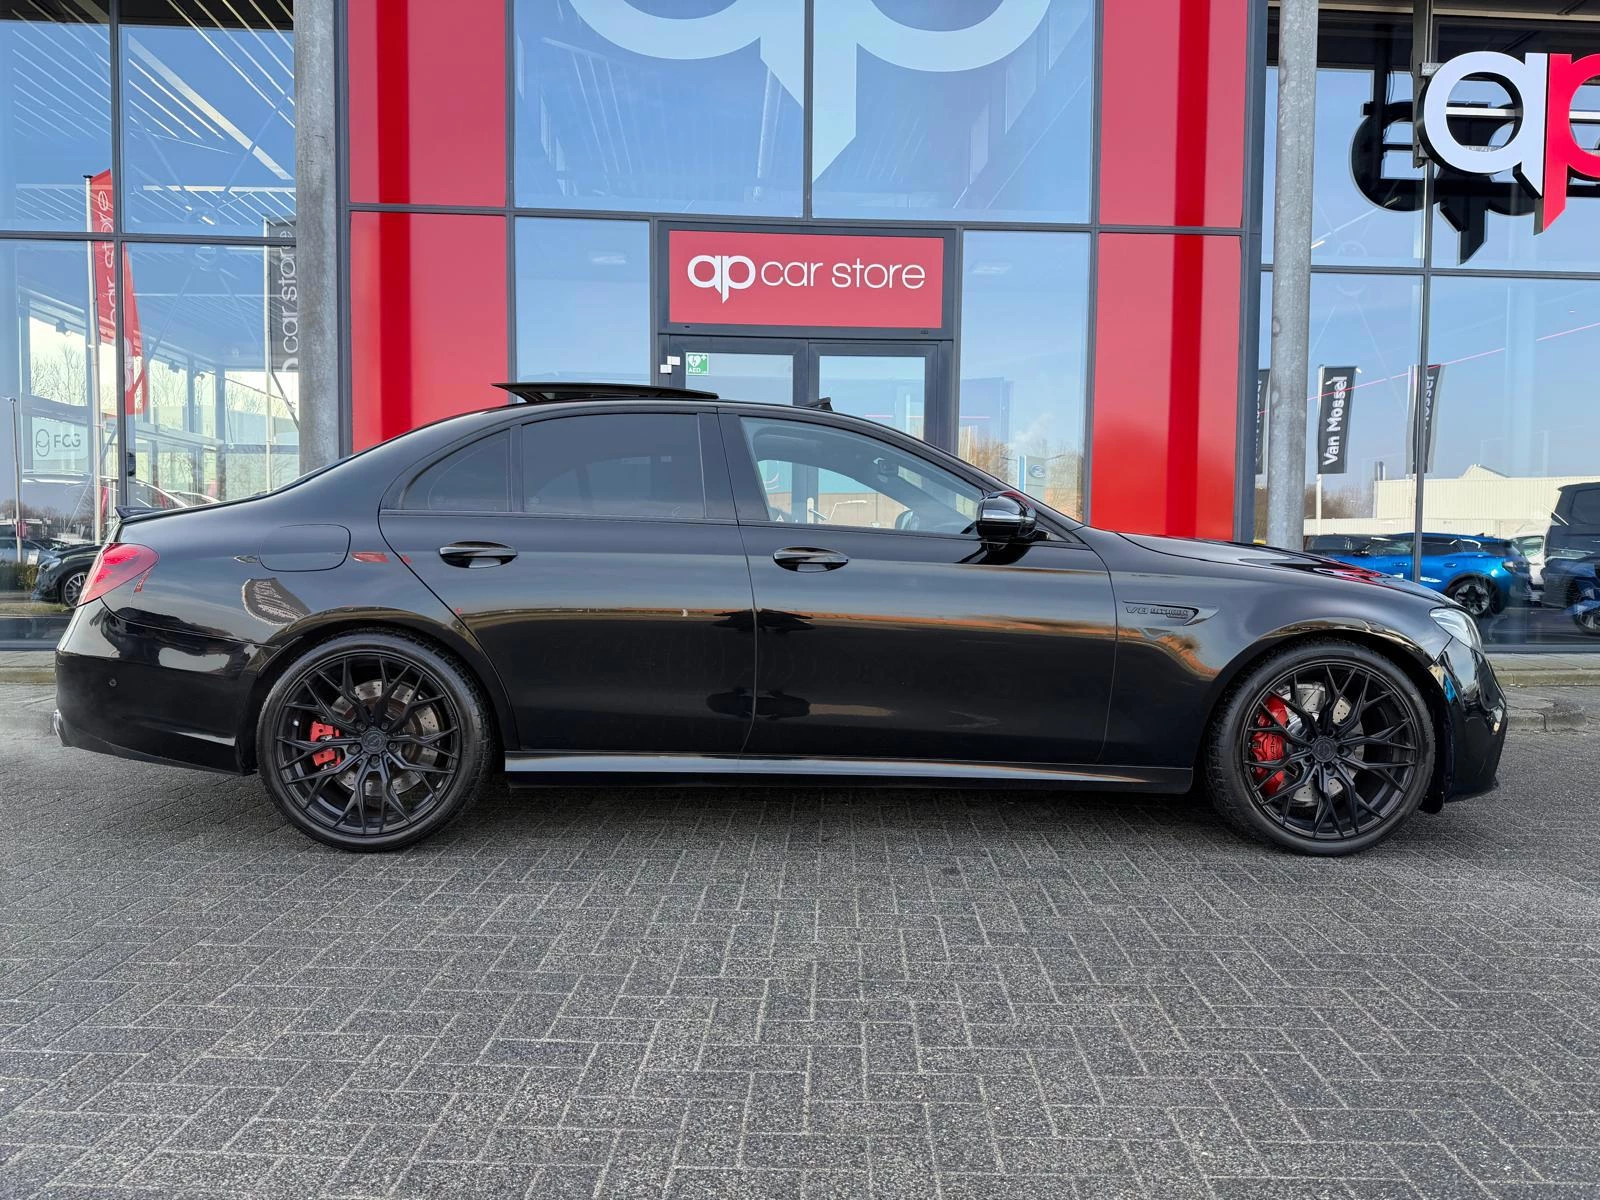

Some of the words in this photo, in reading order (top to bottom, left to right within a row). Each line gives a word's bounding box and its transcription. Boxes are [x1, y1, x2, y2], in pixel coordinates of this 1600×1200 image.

[687, 255, 756, 303] ap
[760, 261, 824, 287] car
[831, 258, 926, 290] store
[282, 306, 299, 354] car
[1326, 376, 1348, 433] Mossel
[53, 433, 81, 448] FCG
[1322, 435, 1340, 466] Van
